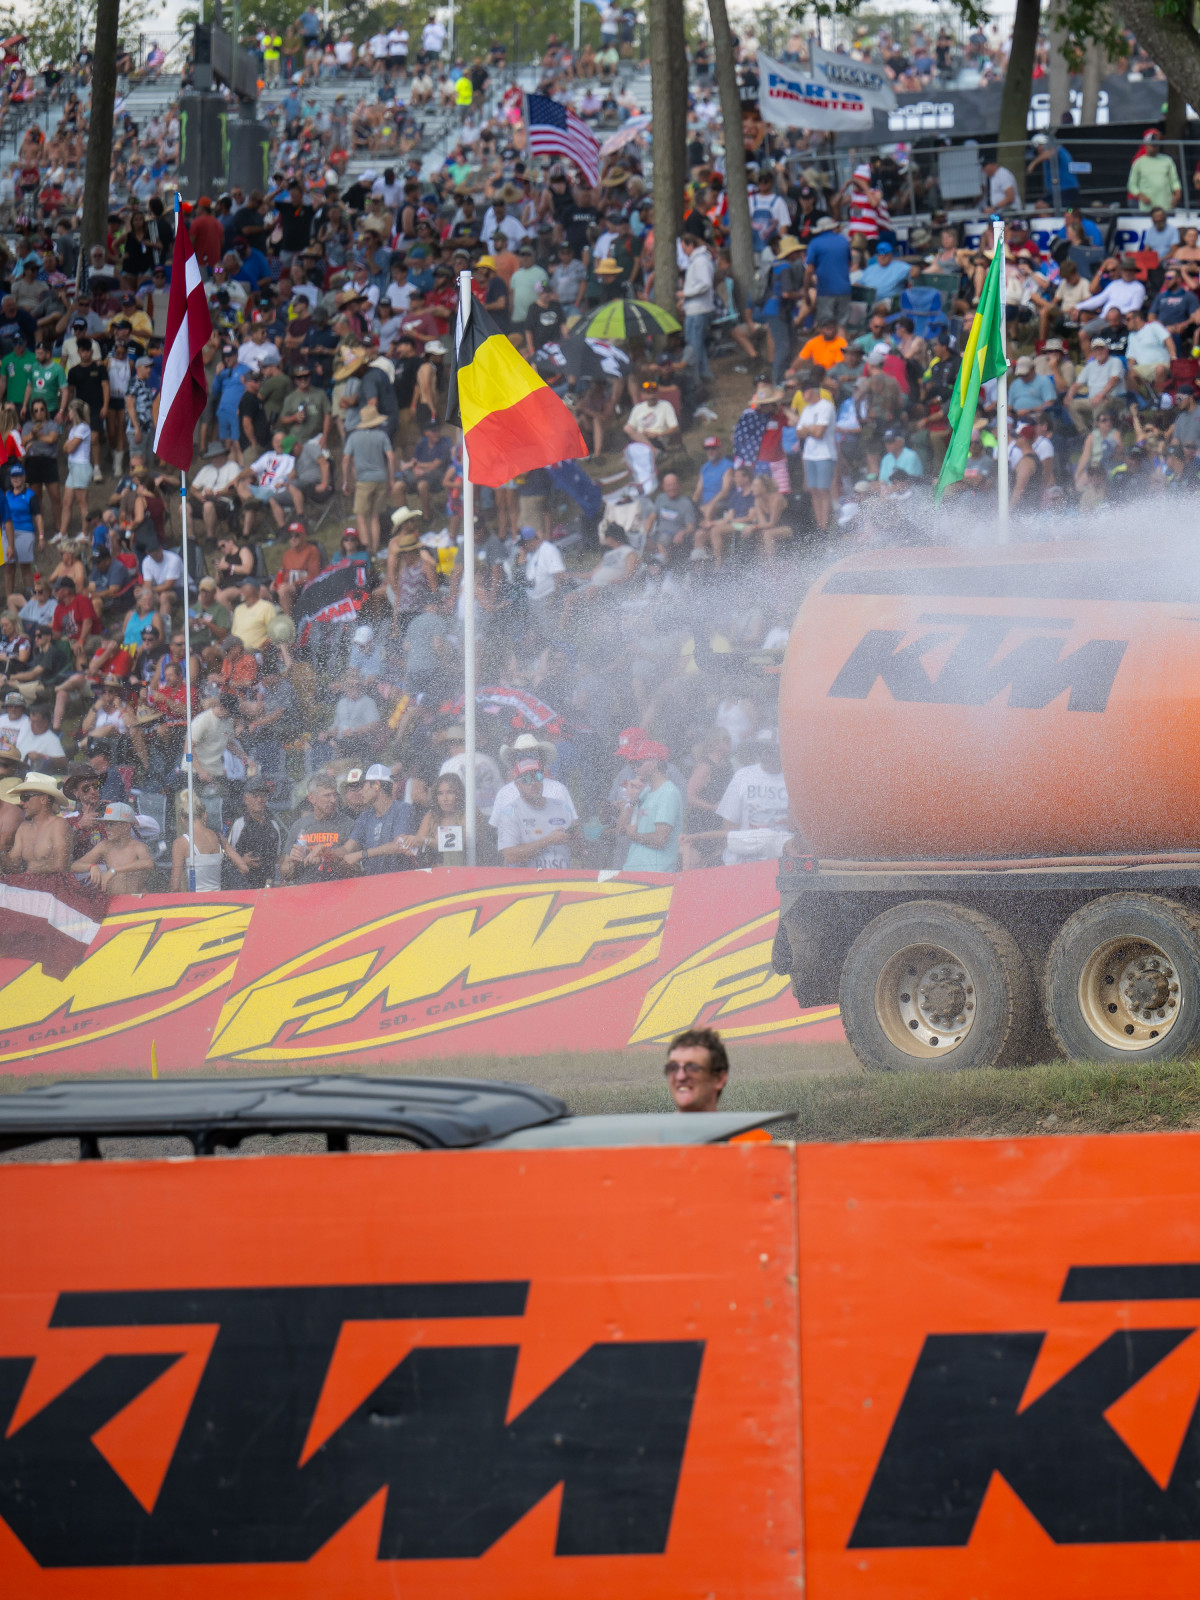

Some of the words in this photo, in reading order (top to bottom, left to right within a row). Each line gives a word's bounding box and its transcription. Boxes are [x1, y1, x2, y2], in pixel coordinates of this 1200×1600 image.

[768, 73, 863, 101] PARTS
[769, 88, 864, 111] UNLIMITED
[826, 613, 1129, 713] KTM
[747, 785, 788, 801] BUSC
[444, 832, 456, 848] 2
[205, 884, 674, 1063] FMF
[426, 990, 503, 1016] CALIF.
